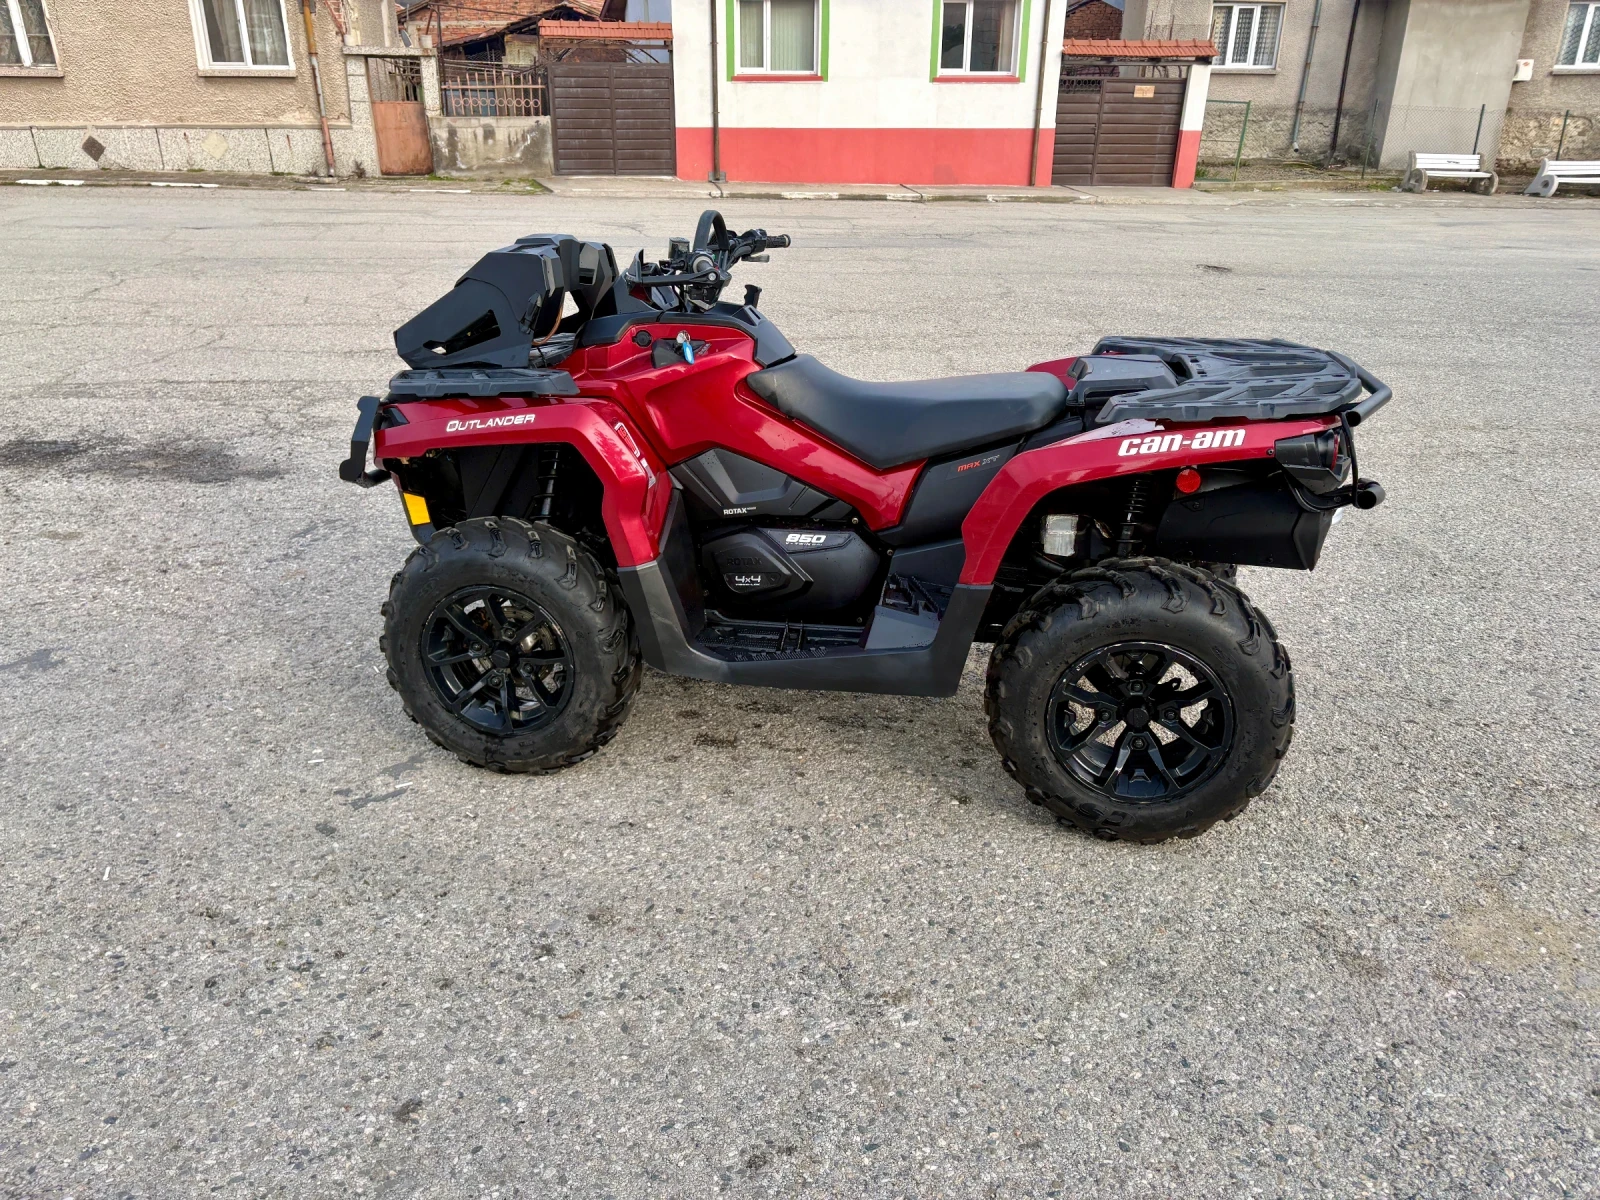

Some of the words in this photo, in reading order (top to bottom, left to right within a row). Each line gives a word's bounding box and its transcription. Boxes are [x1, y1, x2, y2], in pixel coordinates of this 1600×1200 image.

[446, 413, 535, 432] OUTLANDER
[1117, 428, 1246, 457] can-am
[957, 460, 981, 472] MAX
[723, 507, 748, 515] ROTAX
[785, 533, 827, 543] 850
[727, 557, 762, 566] ROTAX
[735, 575, 762, 583] 4x4
